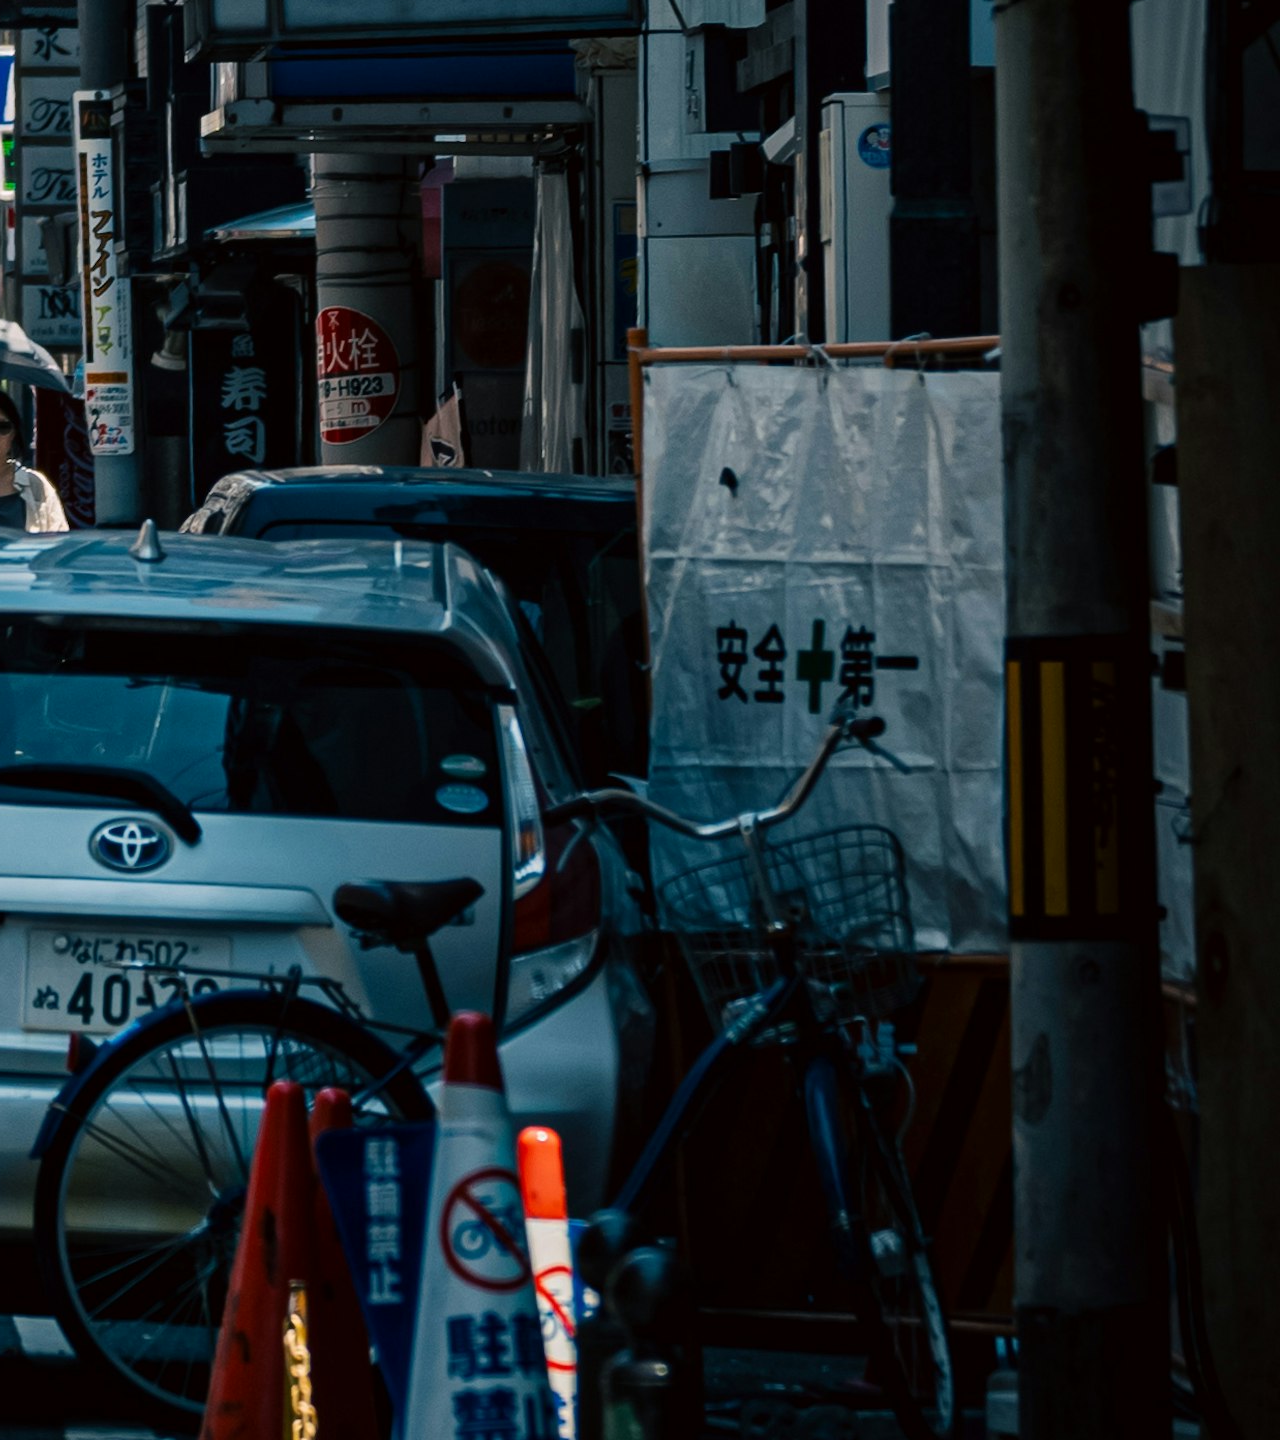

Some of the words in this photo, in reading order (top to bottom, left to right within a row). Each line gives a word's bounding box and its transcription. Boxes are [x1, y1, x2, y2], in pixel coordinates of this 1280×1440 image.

[91, 153, 110, 200] ホテル
[90, 209, 115, 298] ファイン
[220, 363, 270, 465] 寿司
[72, 936, 138, 965] なにわ
[138, 940, 189, 967] 502
